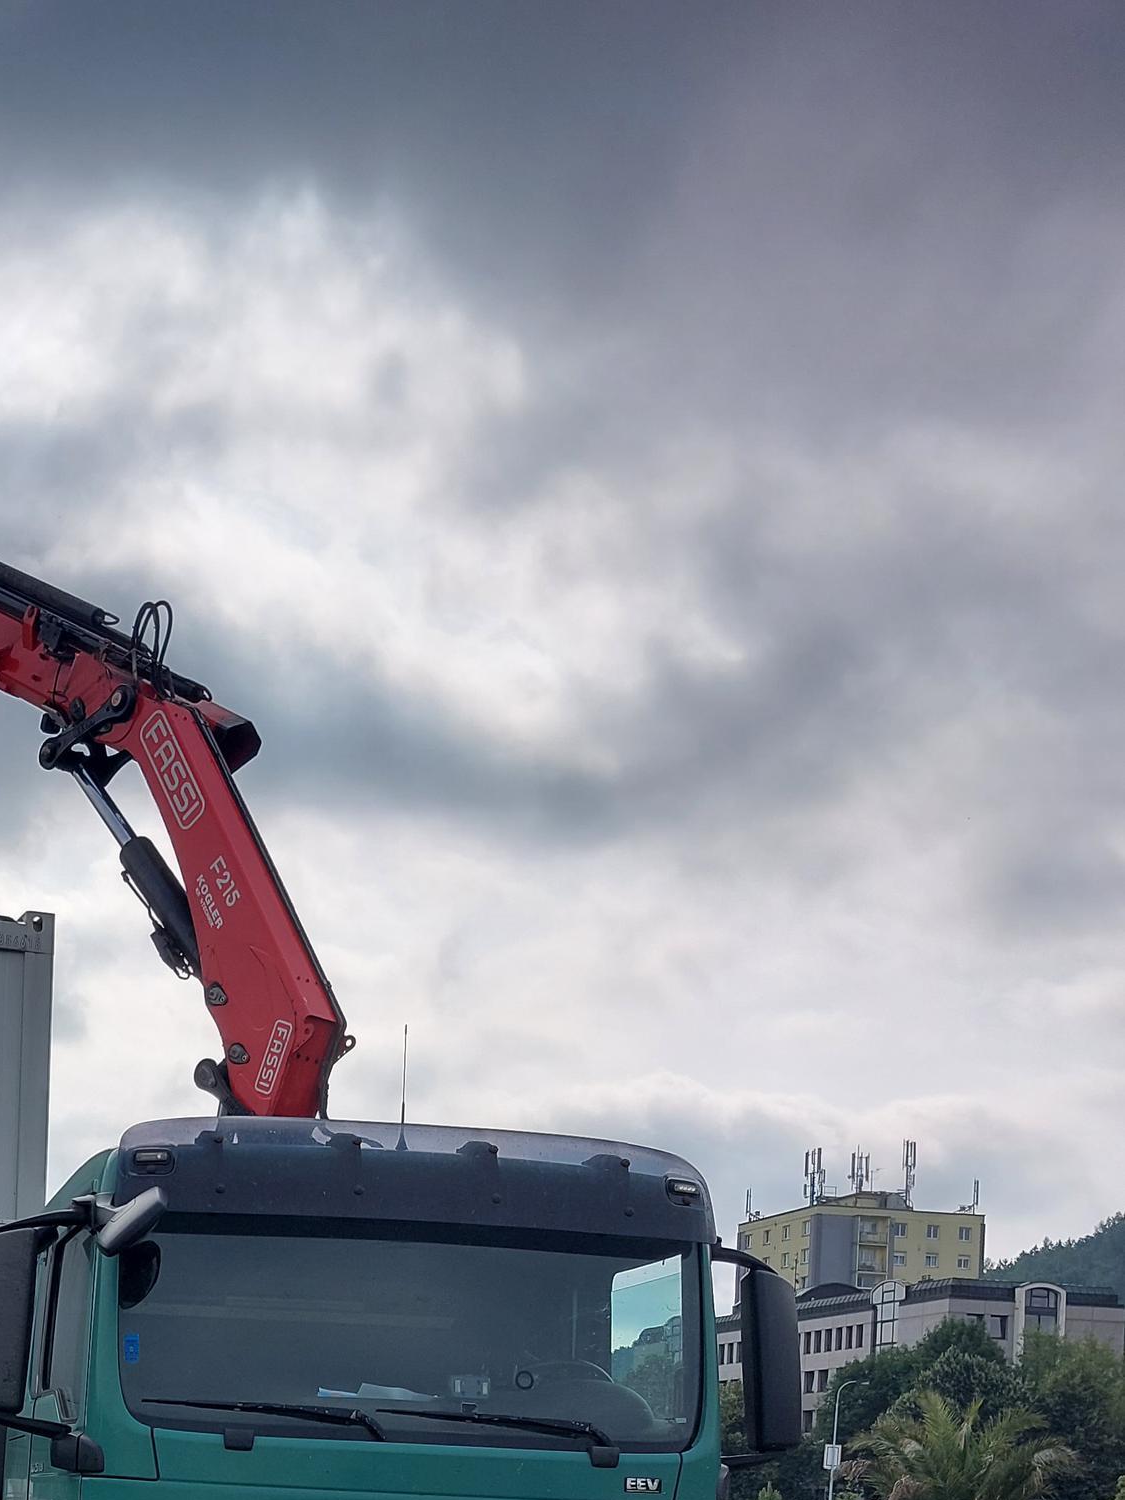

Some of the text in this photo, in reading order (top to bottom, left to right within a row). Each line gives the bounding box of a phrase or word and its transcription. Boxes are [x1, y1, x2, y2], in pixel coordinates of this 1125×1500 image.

[145, 719, 200, 820] FASSI
[209, 855, 241, 907] F215
[259, 1026, 288, 1088] FASSI
[626, 1477, 660, 1490] EEV
